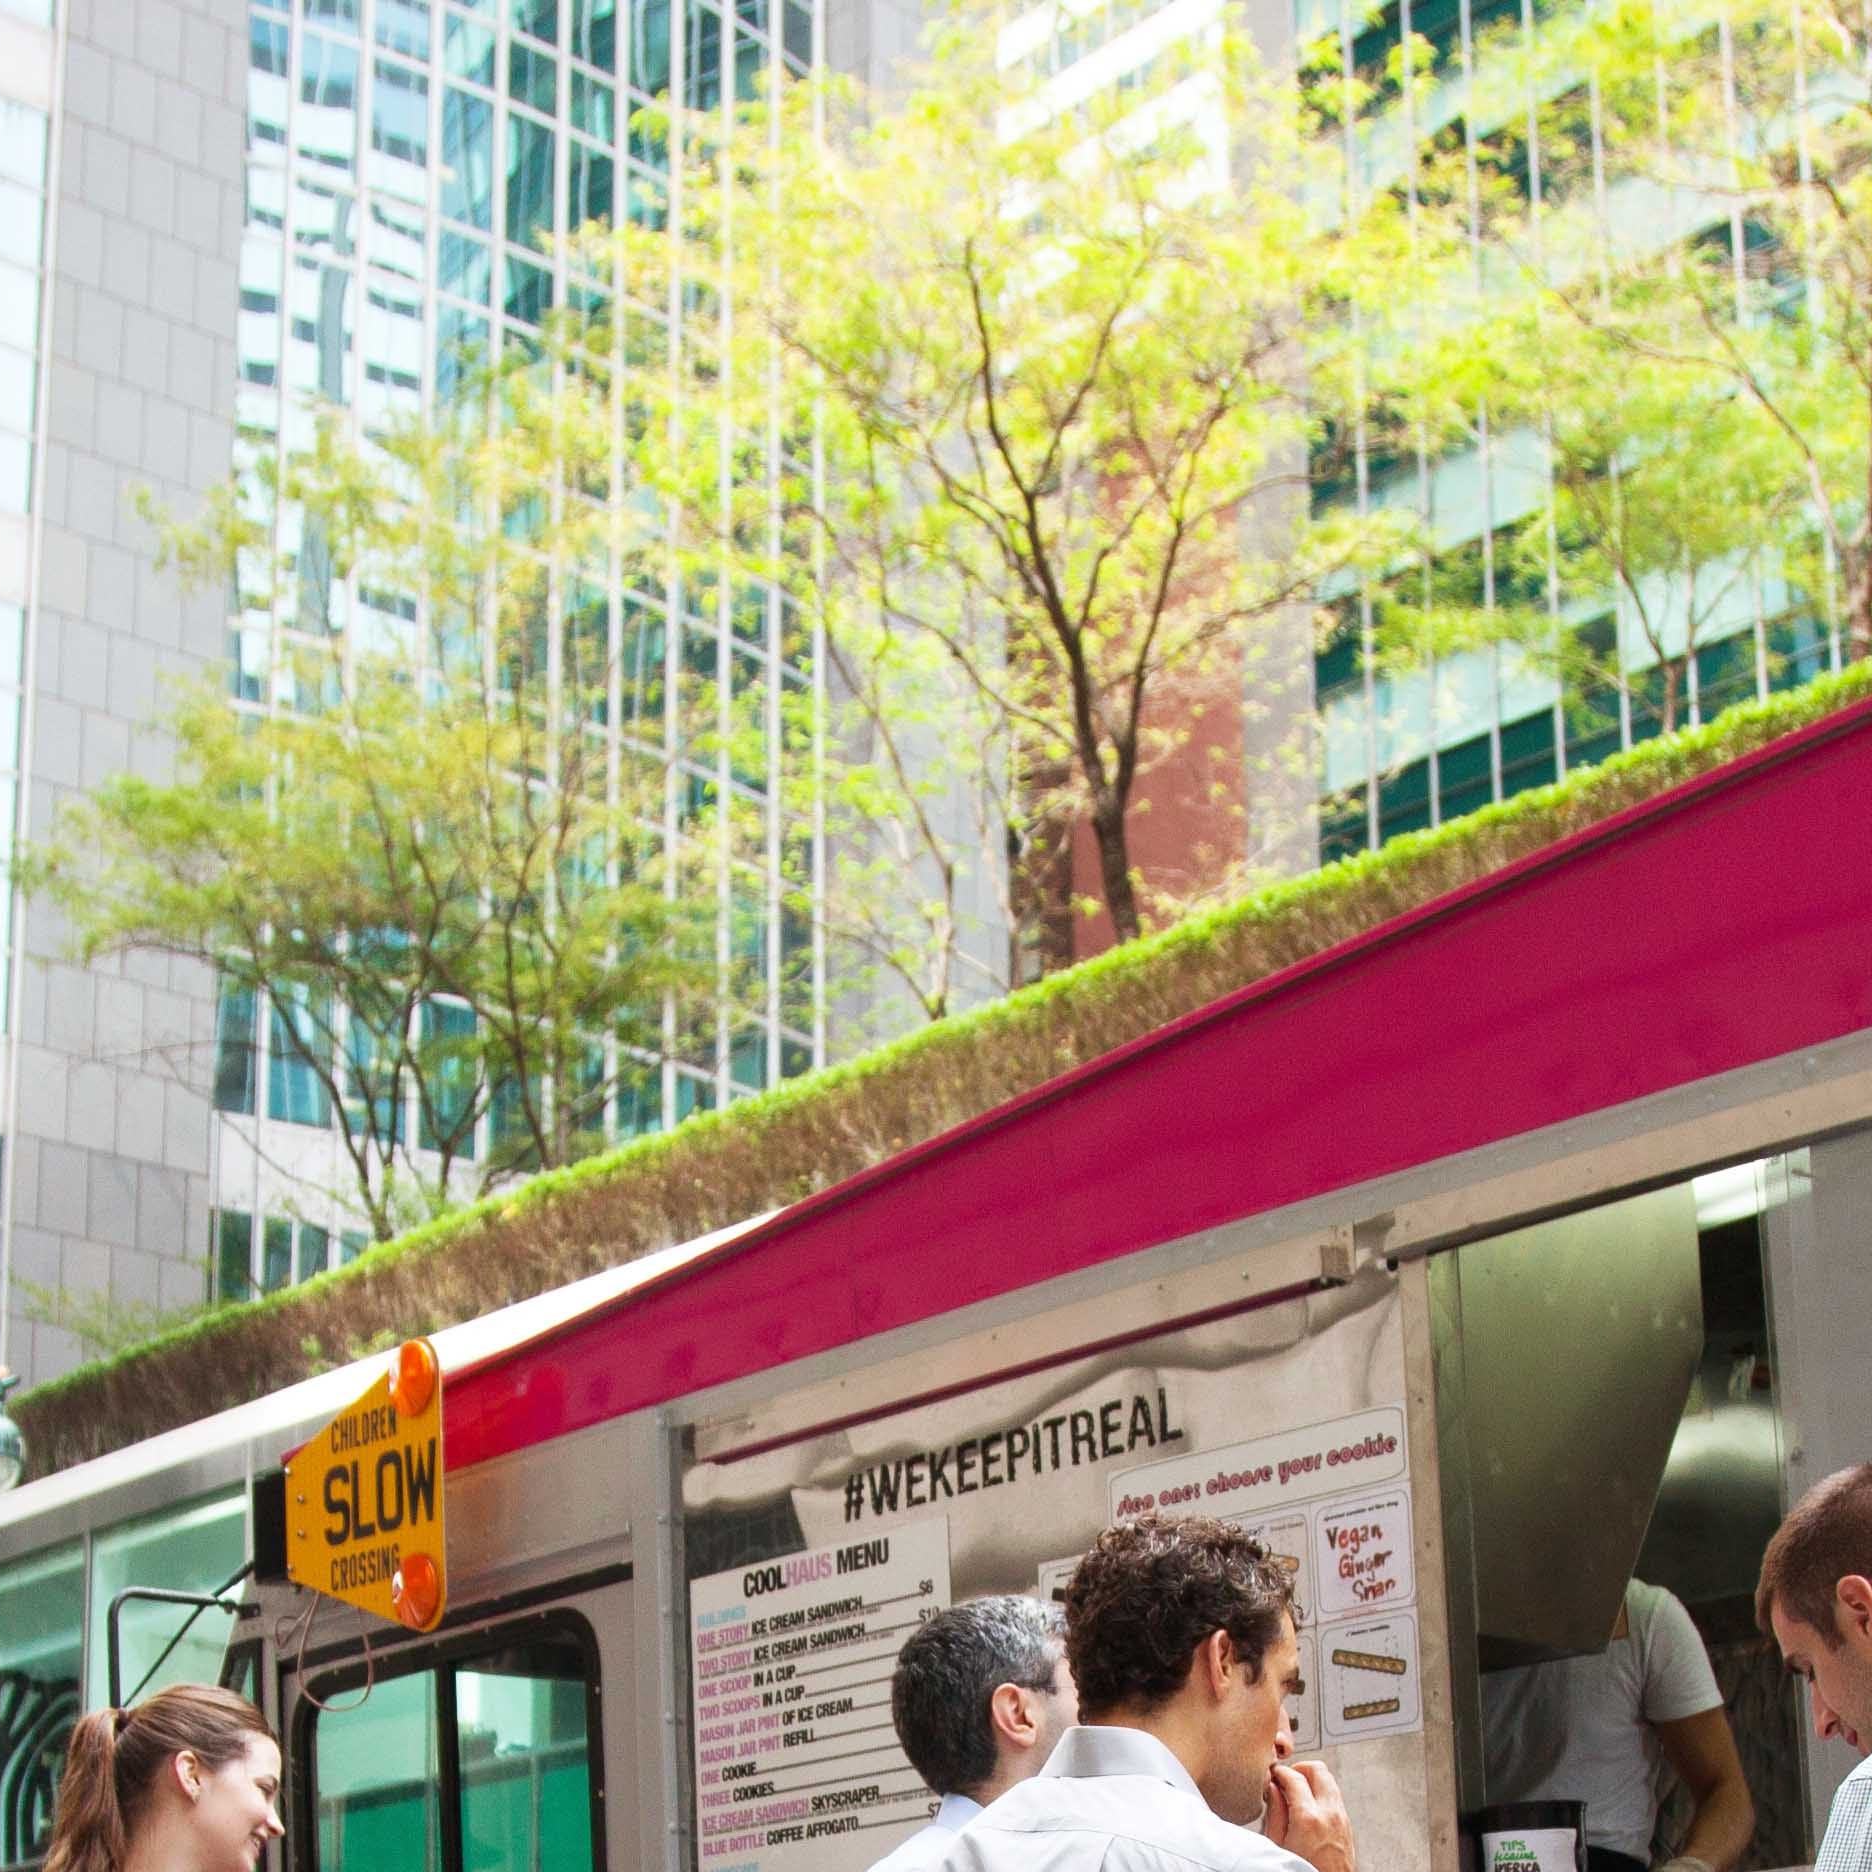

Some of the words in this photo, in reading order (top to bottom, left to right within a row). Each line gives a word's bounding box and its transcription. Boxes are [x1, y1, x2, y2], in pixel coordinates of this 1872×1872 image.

[330, 1404, 398, 1455] CHILDREN
[842, 1386, 1186, 1524] #WEKEEPITREAL
[1159, 1480, 1201, 1510] one:
[1205, 1465, 1274, 1496] choose
[1277, 1453, 1323, 1485] your
[1326, 1432, 1398, 1467] cookie
[323, 1437, 437, 1547] SLOW
[1326, 1523, 1384, 1552] Vegan
[330, 1543, 400, 1592] CROSSING
[744, 1552, 833, 1598] COOLHAUS
[836, 1538, 889, 1575] MENU
[1338, 1550, 1393, 1581] Ginger
[697, 1630, 717, 1650] ONE
[719, 1623, 749, 1644] STORY
[751, 1618, 767, 1636] ICE
[769, 1609, 805, 1631] CREAM
[807, 1595, 863, 1620] SANDWICH
[698, 1657, 719, 1675] TWO
[721, 1650, 752, 1669] STORY
[754, 1644, 769, 1661] ICE
[771, 1635, 808, 1658] CREAM
[810, 1623, 866, 1649] SANDWICH
[698, 1681, 718, 1700] ONE
[720, 1674, 752, 1695] SCOOP
[754, 1671, 764, 1687] IN
[766, 1669, 774, 1685] A
[776, 1664, 797, 1682] CUP
[699, 1704, 720, 1721] TWO
[722, 1696, 760, 1716] SCOOPS
[763, 1692, 773, 1708] IN
[775, 1690, 783, 1705] A
[785, 1685, 806, 1703] CUP
[701, 1769, 720, 1786] ONE
[721, 1762, 757, 1782] COOKIE
[701, 1789, 732, 1808] THREE
[732, 1781, 775, 1803] COOKIES
[1500, 1840, 1526, 1850] TIPS
